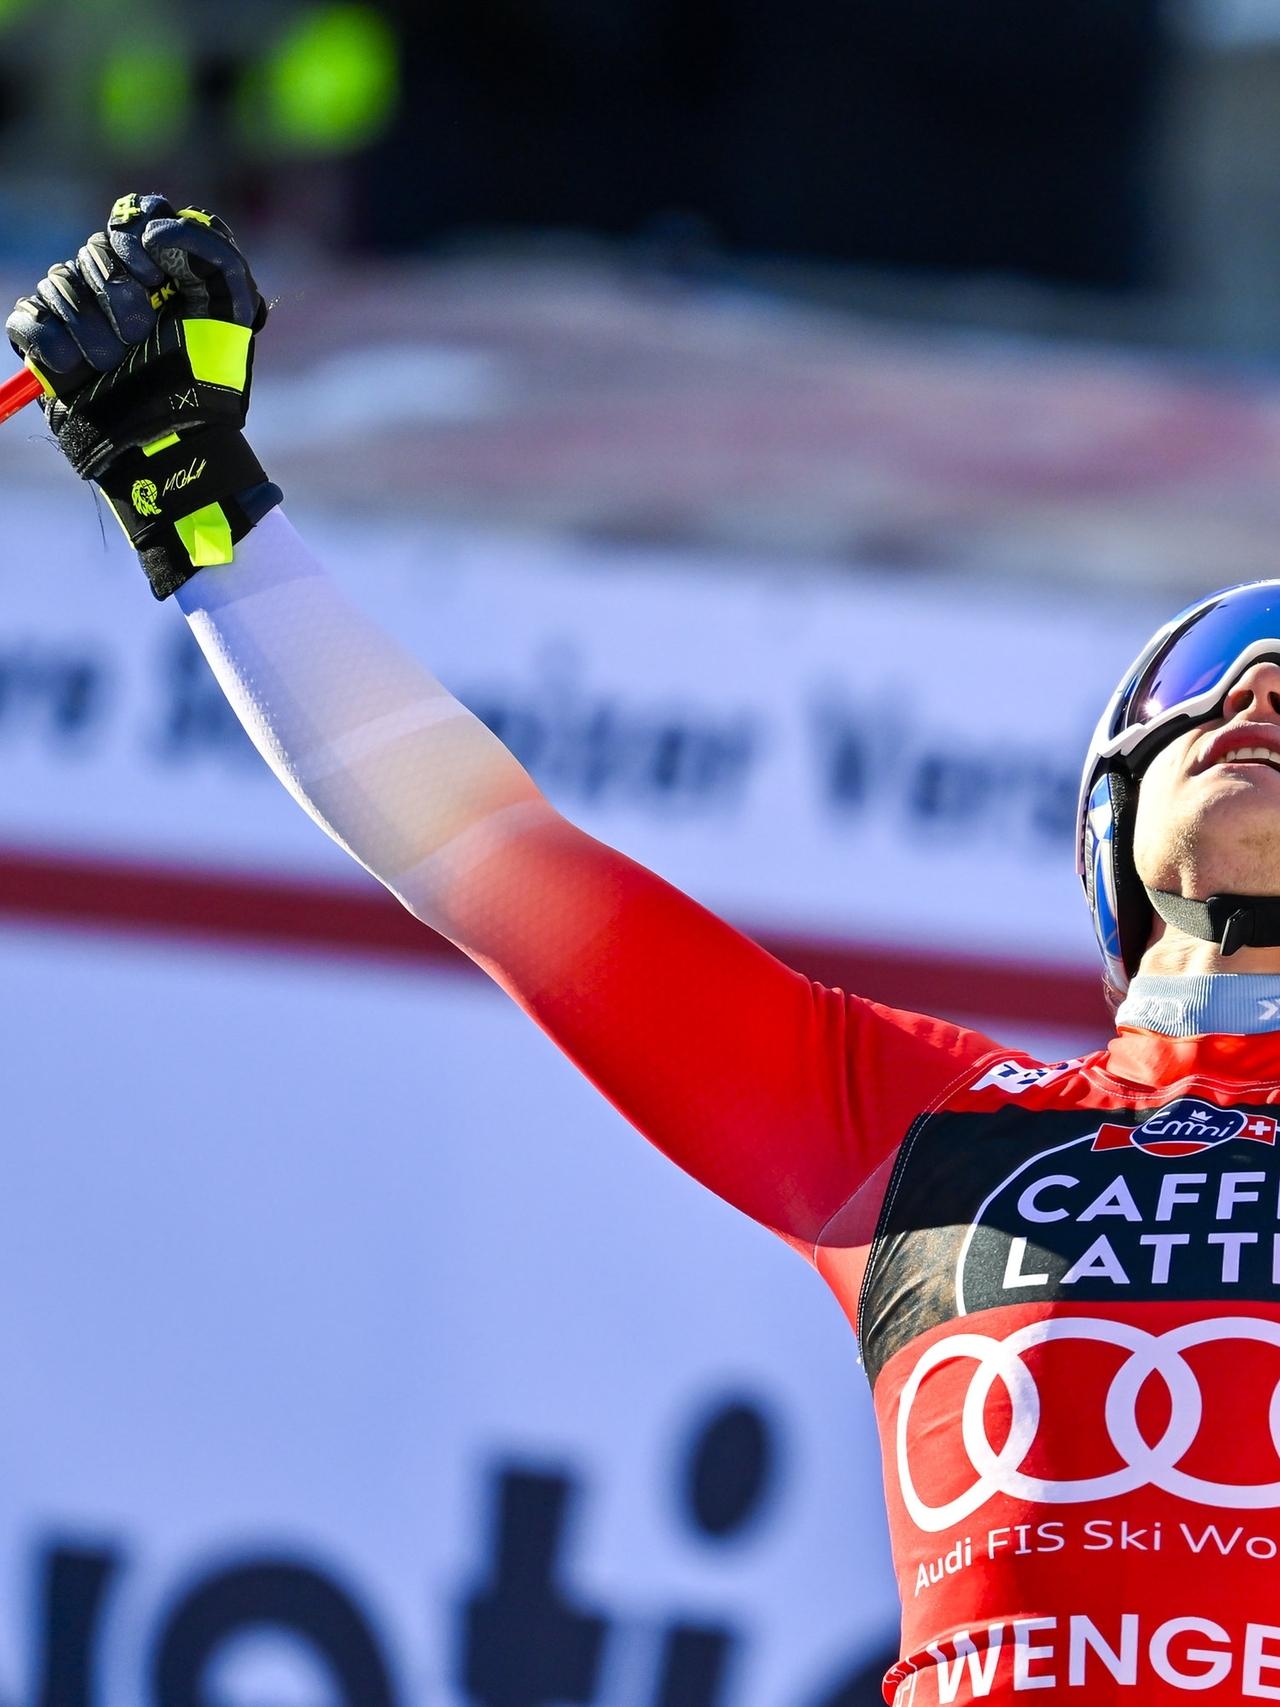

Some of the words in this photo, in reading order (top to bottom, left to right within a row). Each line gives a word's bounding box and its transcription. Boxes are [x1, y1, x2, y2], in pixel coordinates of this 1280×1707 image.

[1141, 1112, 1235, 1137] Emmi
[914, 1537, 972, 1597] Audi
[987, 1521, 1066, 1560] FIS
[1083, 1520, 1162, 1551] Ski
